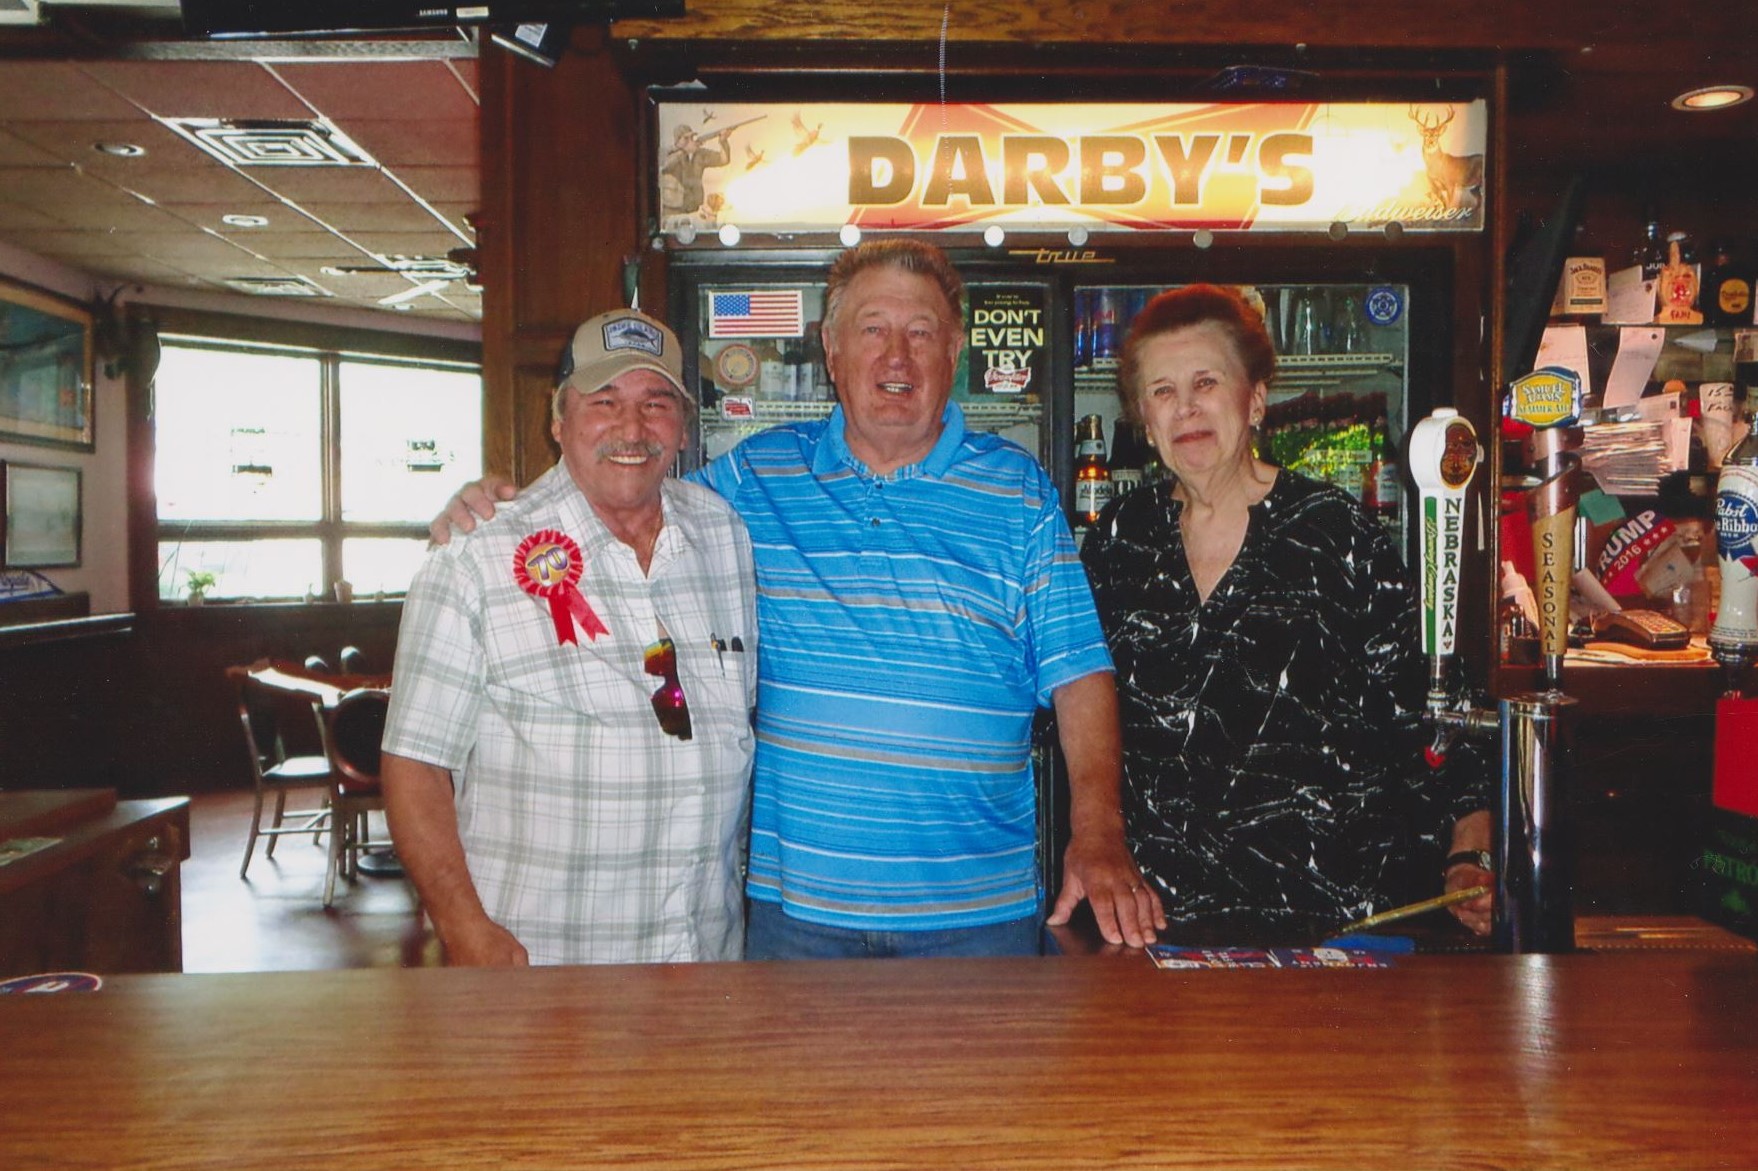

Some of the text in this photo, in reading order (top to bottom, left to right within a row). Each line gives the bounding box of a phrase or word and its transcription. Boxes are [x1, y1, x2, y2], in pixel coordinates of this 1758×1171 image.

[848, 133, 1314, 206] DARBY'S
[1335, 198, 1472, 223] Budweiser
[1009, 248, 1115, 264] true
[974, 309, 1042, 325] DON'T
[971, 327, 1044, 347] EVEN
[982, 349, 1033, 369] TRY
[1716, 498, 1749, 518] Pabst
[1721, 517, 1758, 533] Ribbo
[1598, 510, 1656, 572] RUMP
[527, 546, 569, 581] 70
[1442, 498, 1462, 637] NEBRASKA
[1614, 544, 1642, 571] 2016
[1541, 532, 1556, 653] SEASONAL
